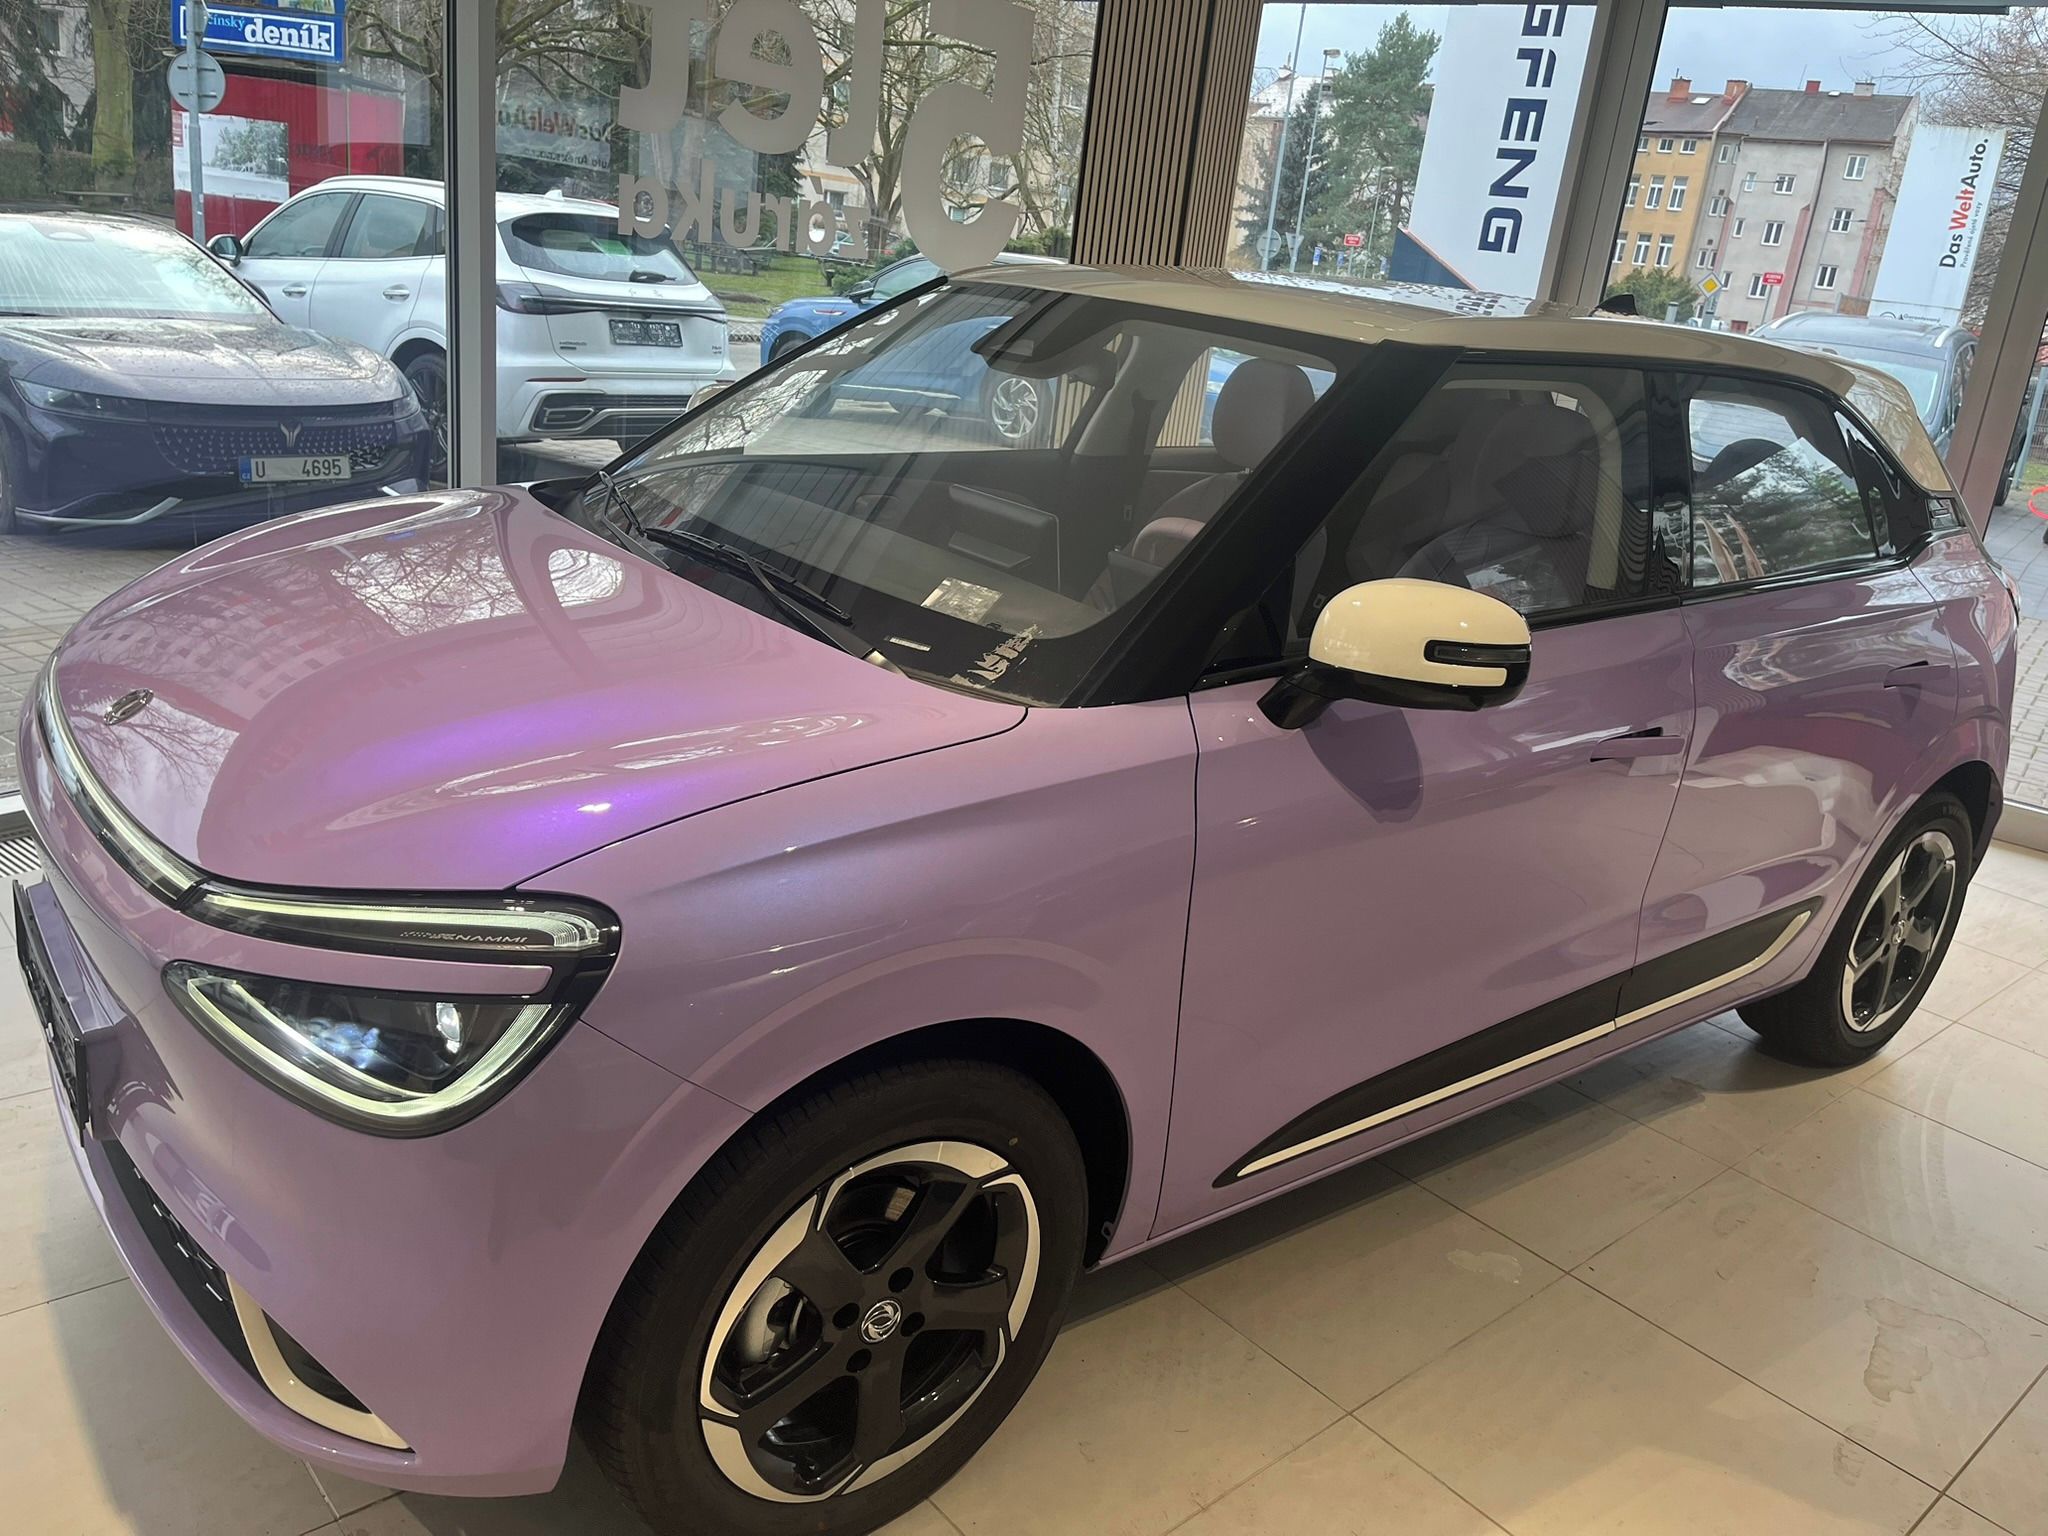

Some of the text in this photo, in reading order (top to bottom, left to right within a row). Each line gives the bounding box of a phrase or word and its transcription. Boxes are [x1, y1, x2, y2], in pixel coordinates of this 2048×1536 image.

[244, 17, 331, 51] deník
[1478, 4, 1568, 254] GFENG
[1939, 233, 1963, 268] Das
[255, 458, 342, 479] U 4695
